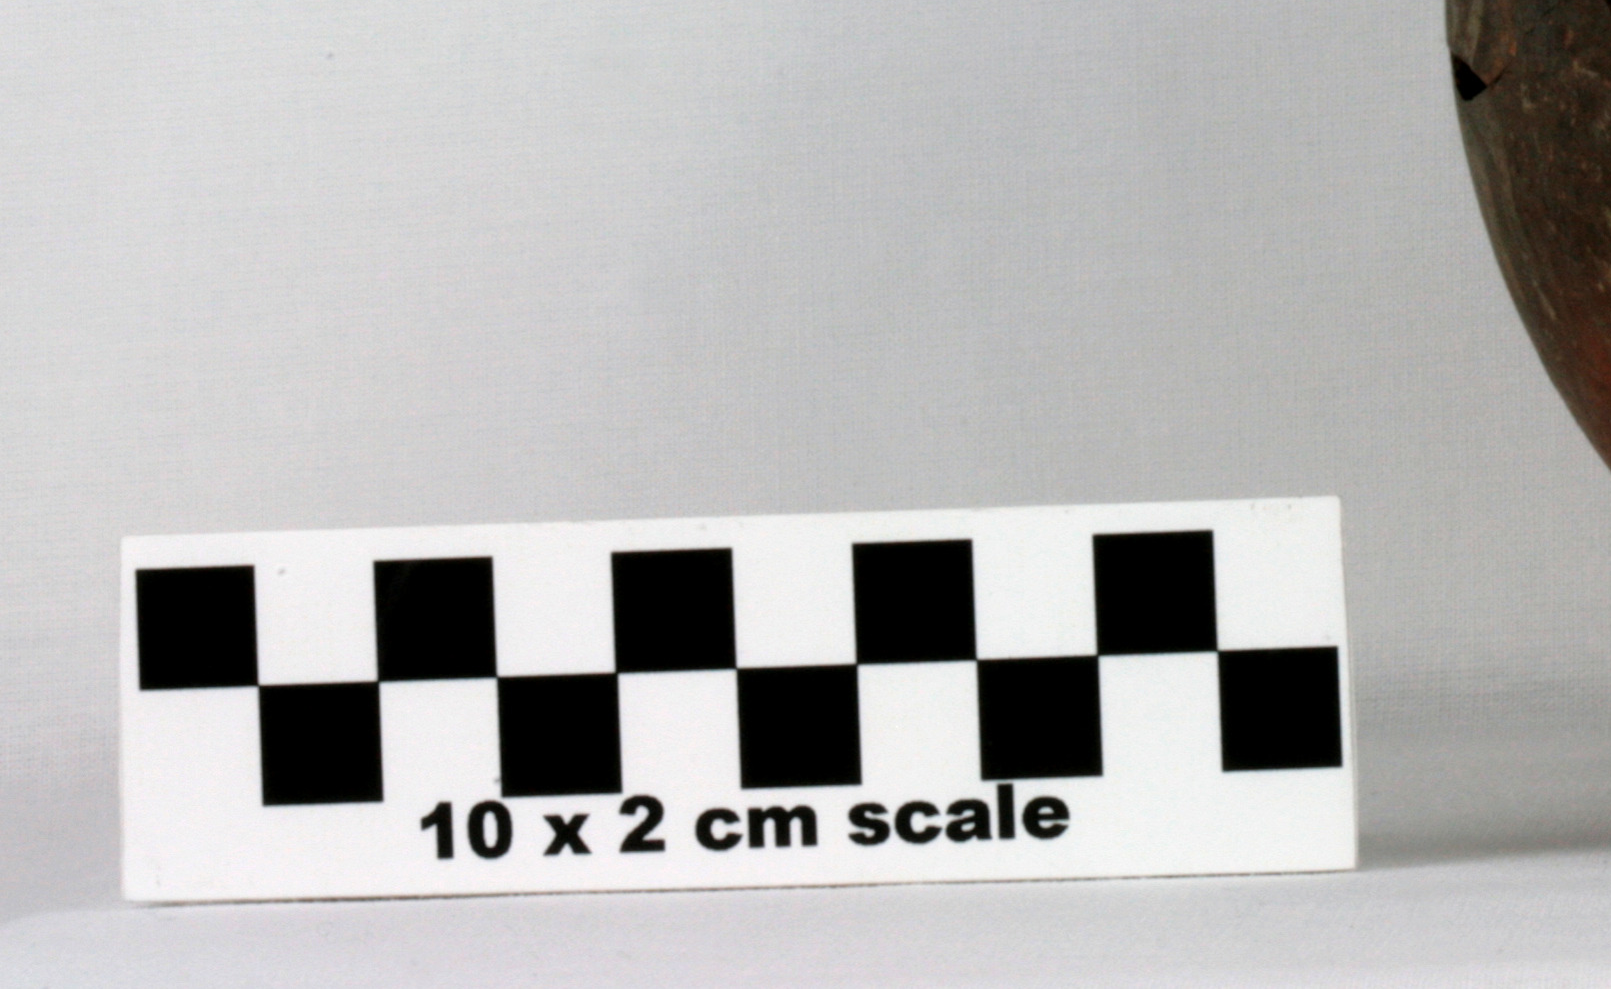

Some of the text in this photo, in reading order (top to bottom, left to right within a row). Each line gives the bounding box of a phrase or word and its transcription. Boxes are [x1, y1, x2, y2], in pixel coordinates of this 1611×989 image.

[420, 783, 1071, 859] 10 x 2 cm scale
